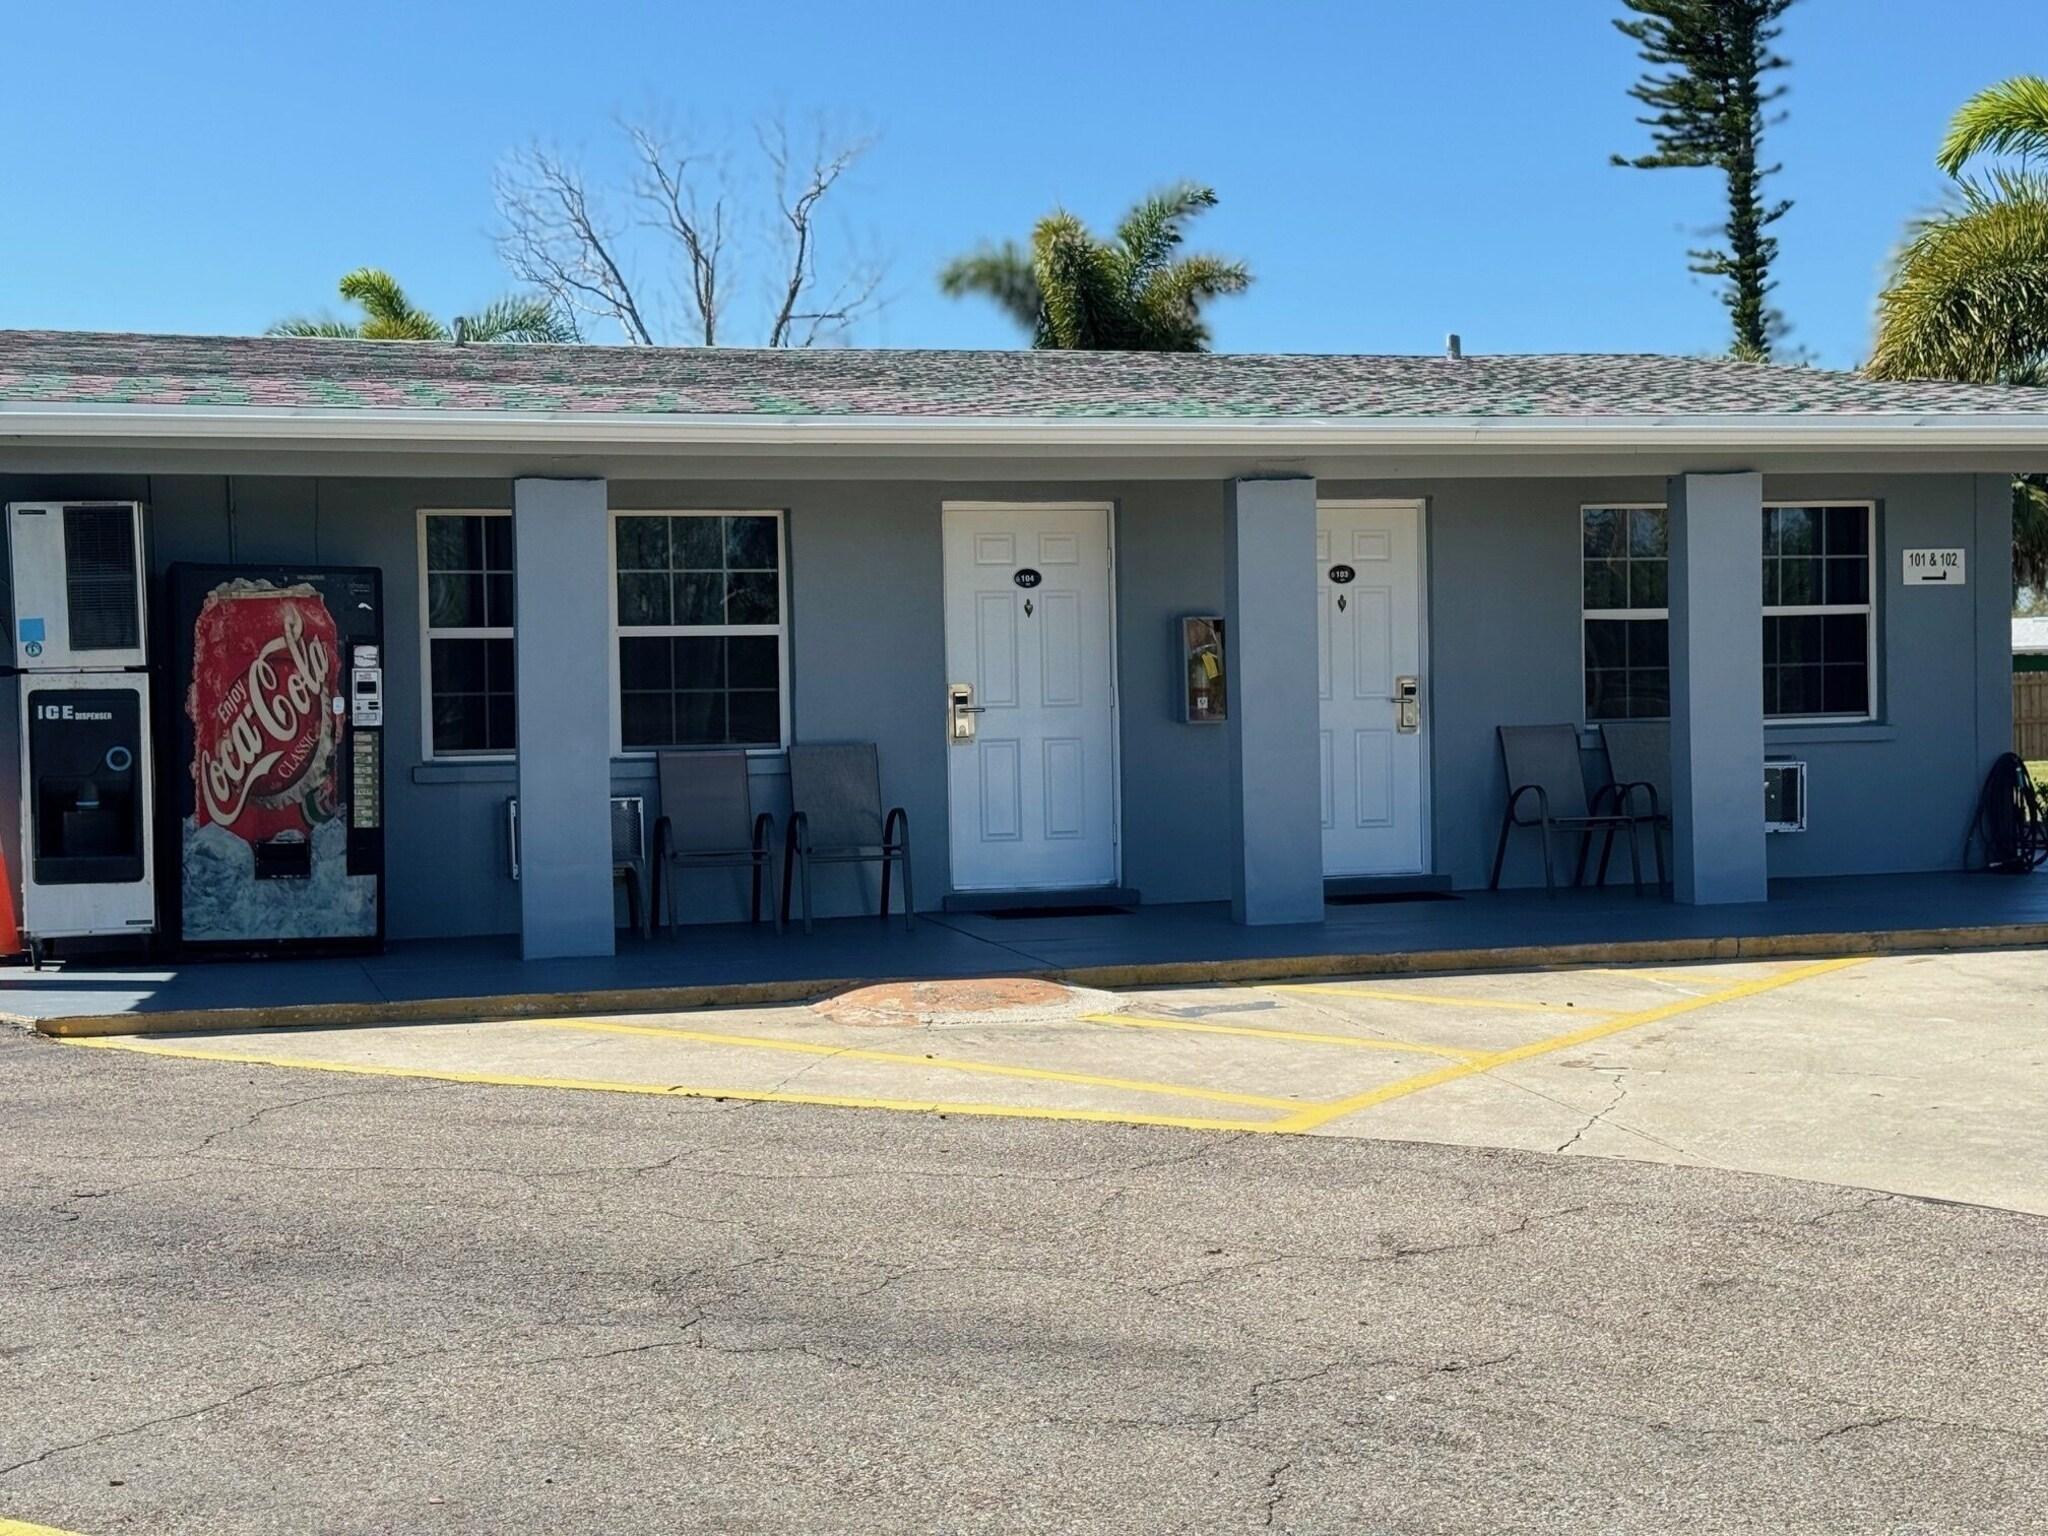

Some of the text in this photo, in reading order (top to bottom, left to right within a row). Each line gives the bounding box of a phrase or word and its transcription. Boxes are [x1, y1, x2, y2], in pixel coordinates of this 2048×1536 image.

[1909, 552, 1958, 567] 101 & 102
[1020, 574, 1035, 583] 104
[37, 705, 113, 721] ICE DISPENSER
[217, 678, 248, 723] Enjoy
[201, 606, 329, 826] Coca-Cola
[277, 728, 319, 779] CLASSIC
